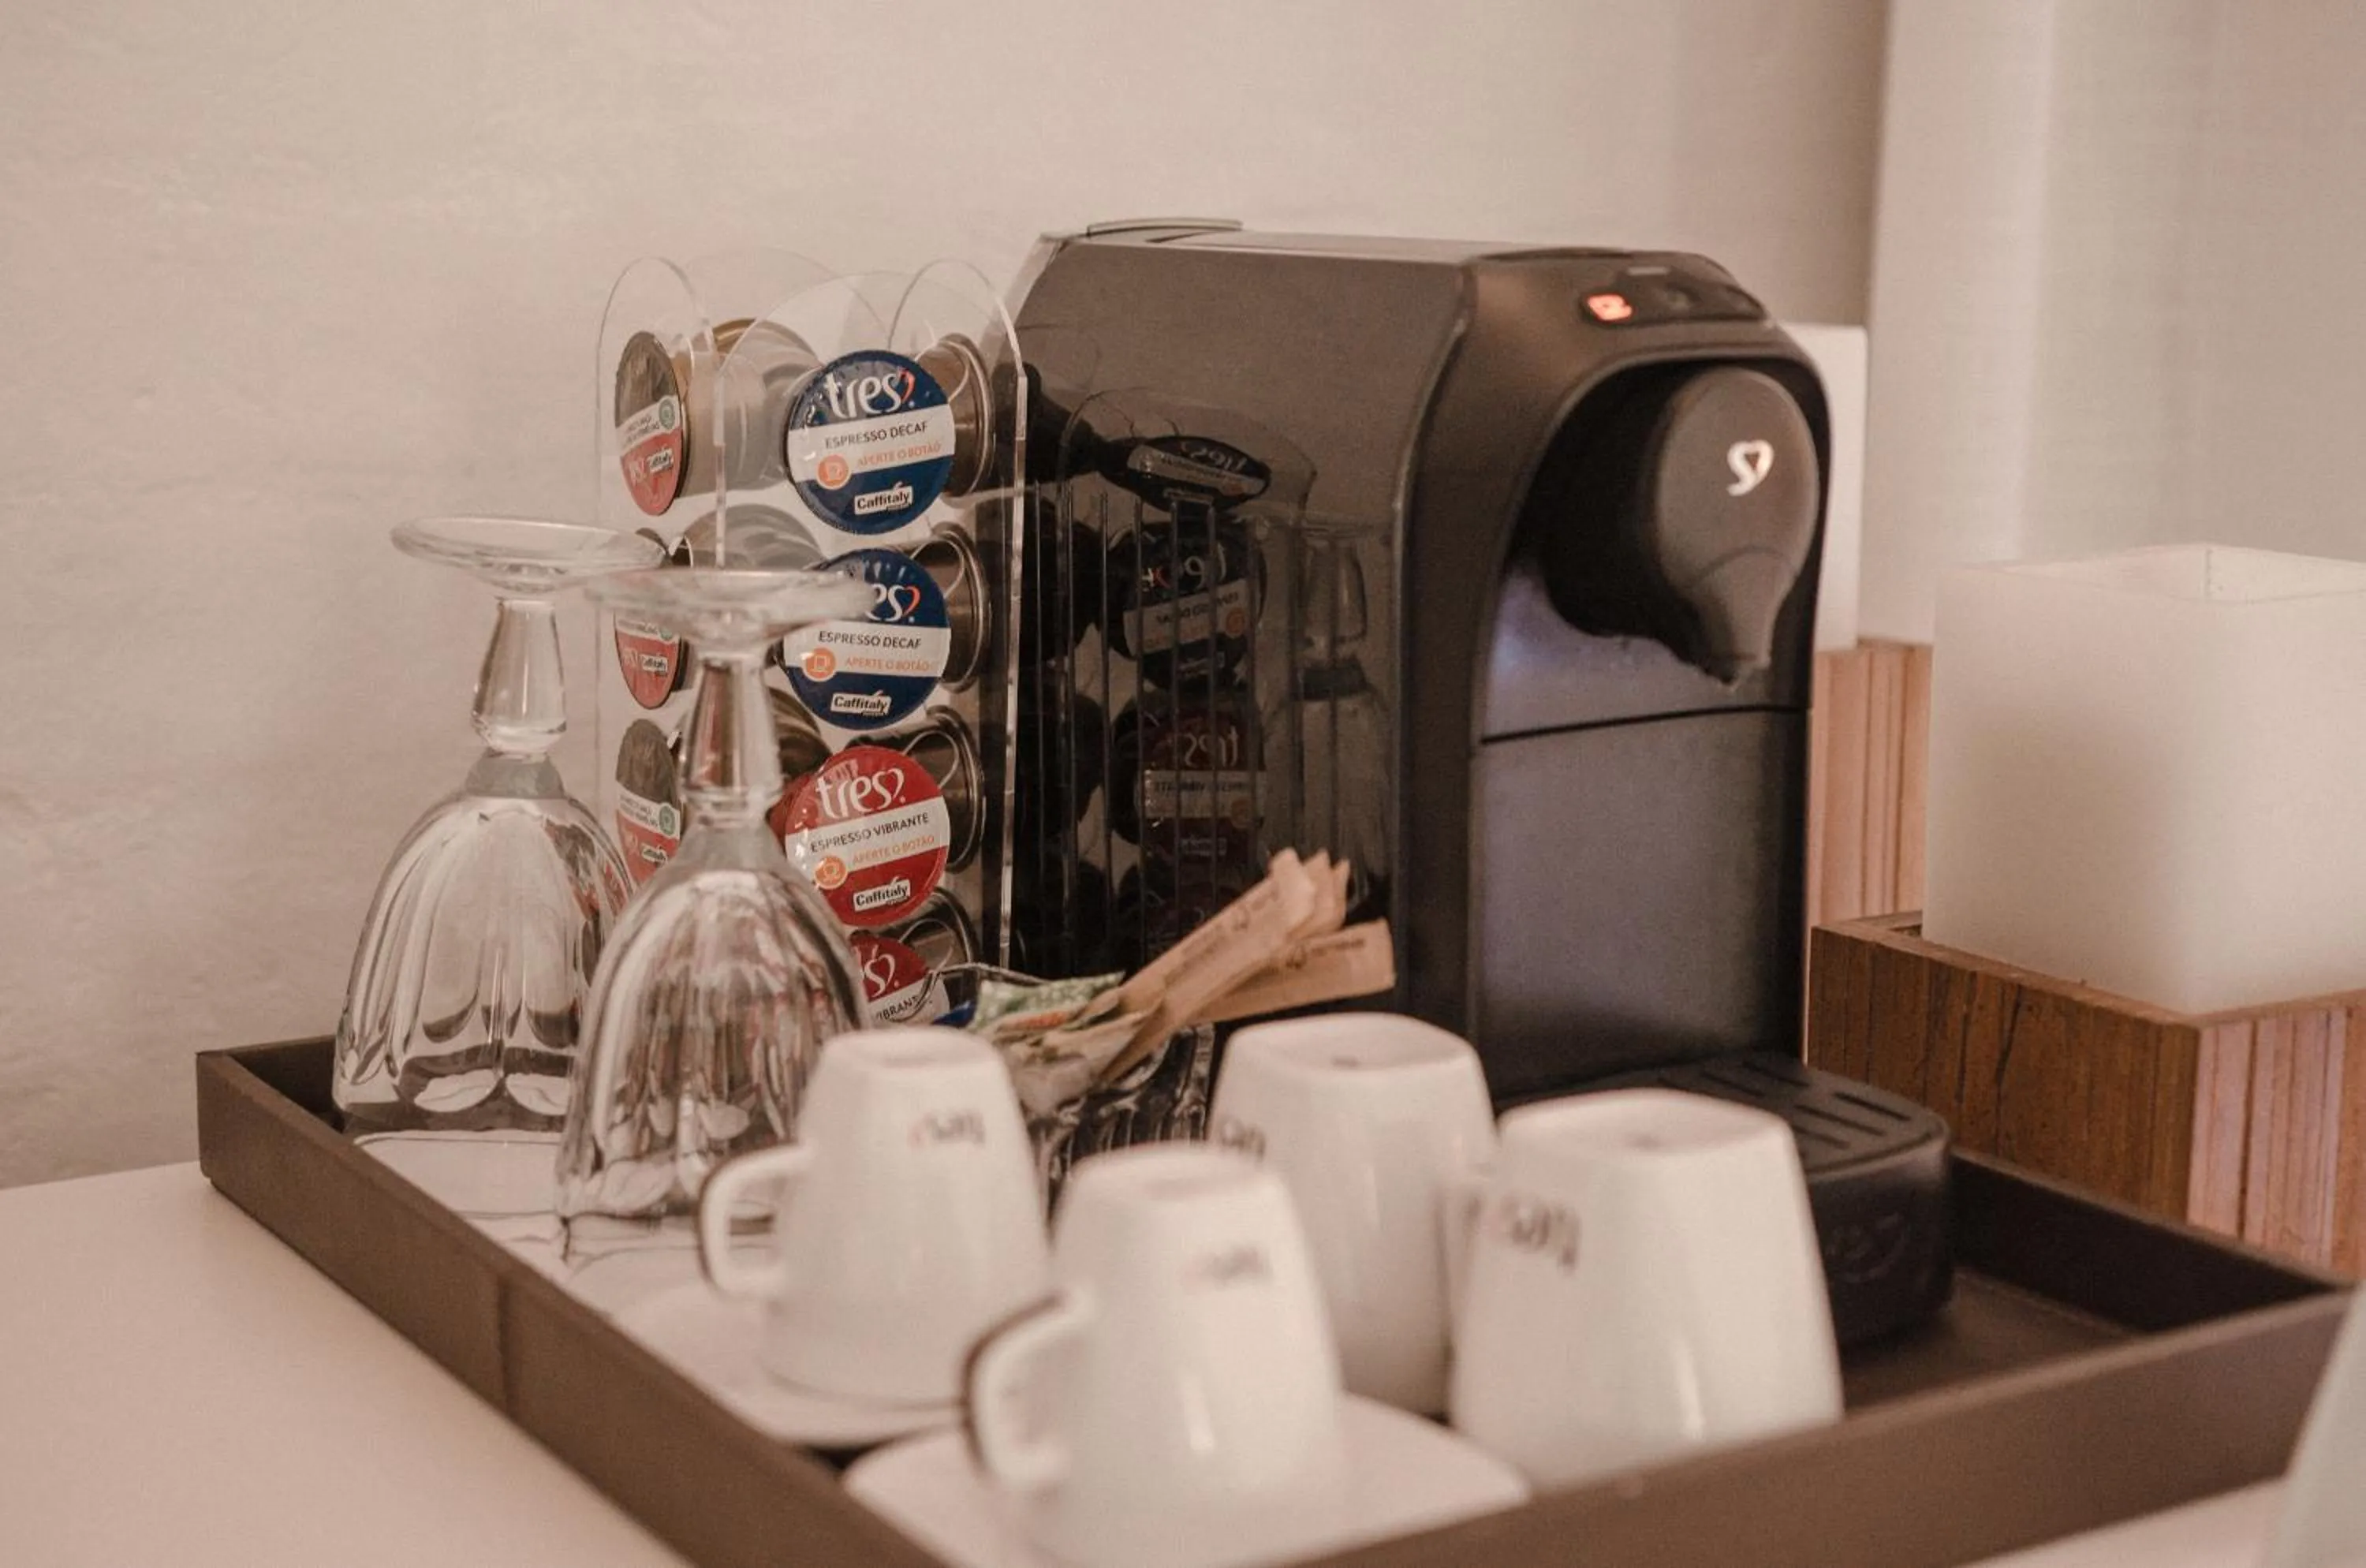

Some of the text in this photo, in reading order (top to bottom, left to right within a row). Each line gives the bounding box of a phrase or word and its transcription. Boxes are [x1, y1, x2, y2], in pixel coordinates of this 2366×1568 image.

[823, 371, 902, 419] tres
[825, 420, 928, 450] ESPRESSO DECAF
[856, 488, 911, 510] Caffitaly
[818, 630, 922, 650] ESPRESSO DECAF
[845, 656, 883, 670] APERTE
[834, 696, 888, 711] Caffitaly
[815, 771, 893, 819] tres
[811, 812, 929, 853] ESPRESSO VIBRANTE
[856, 884, 909, 907] Caffitaly
